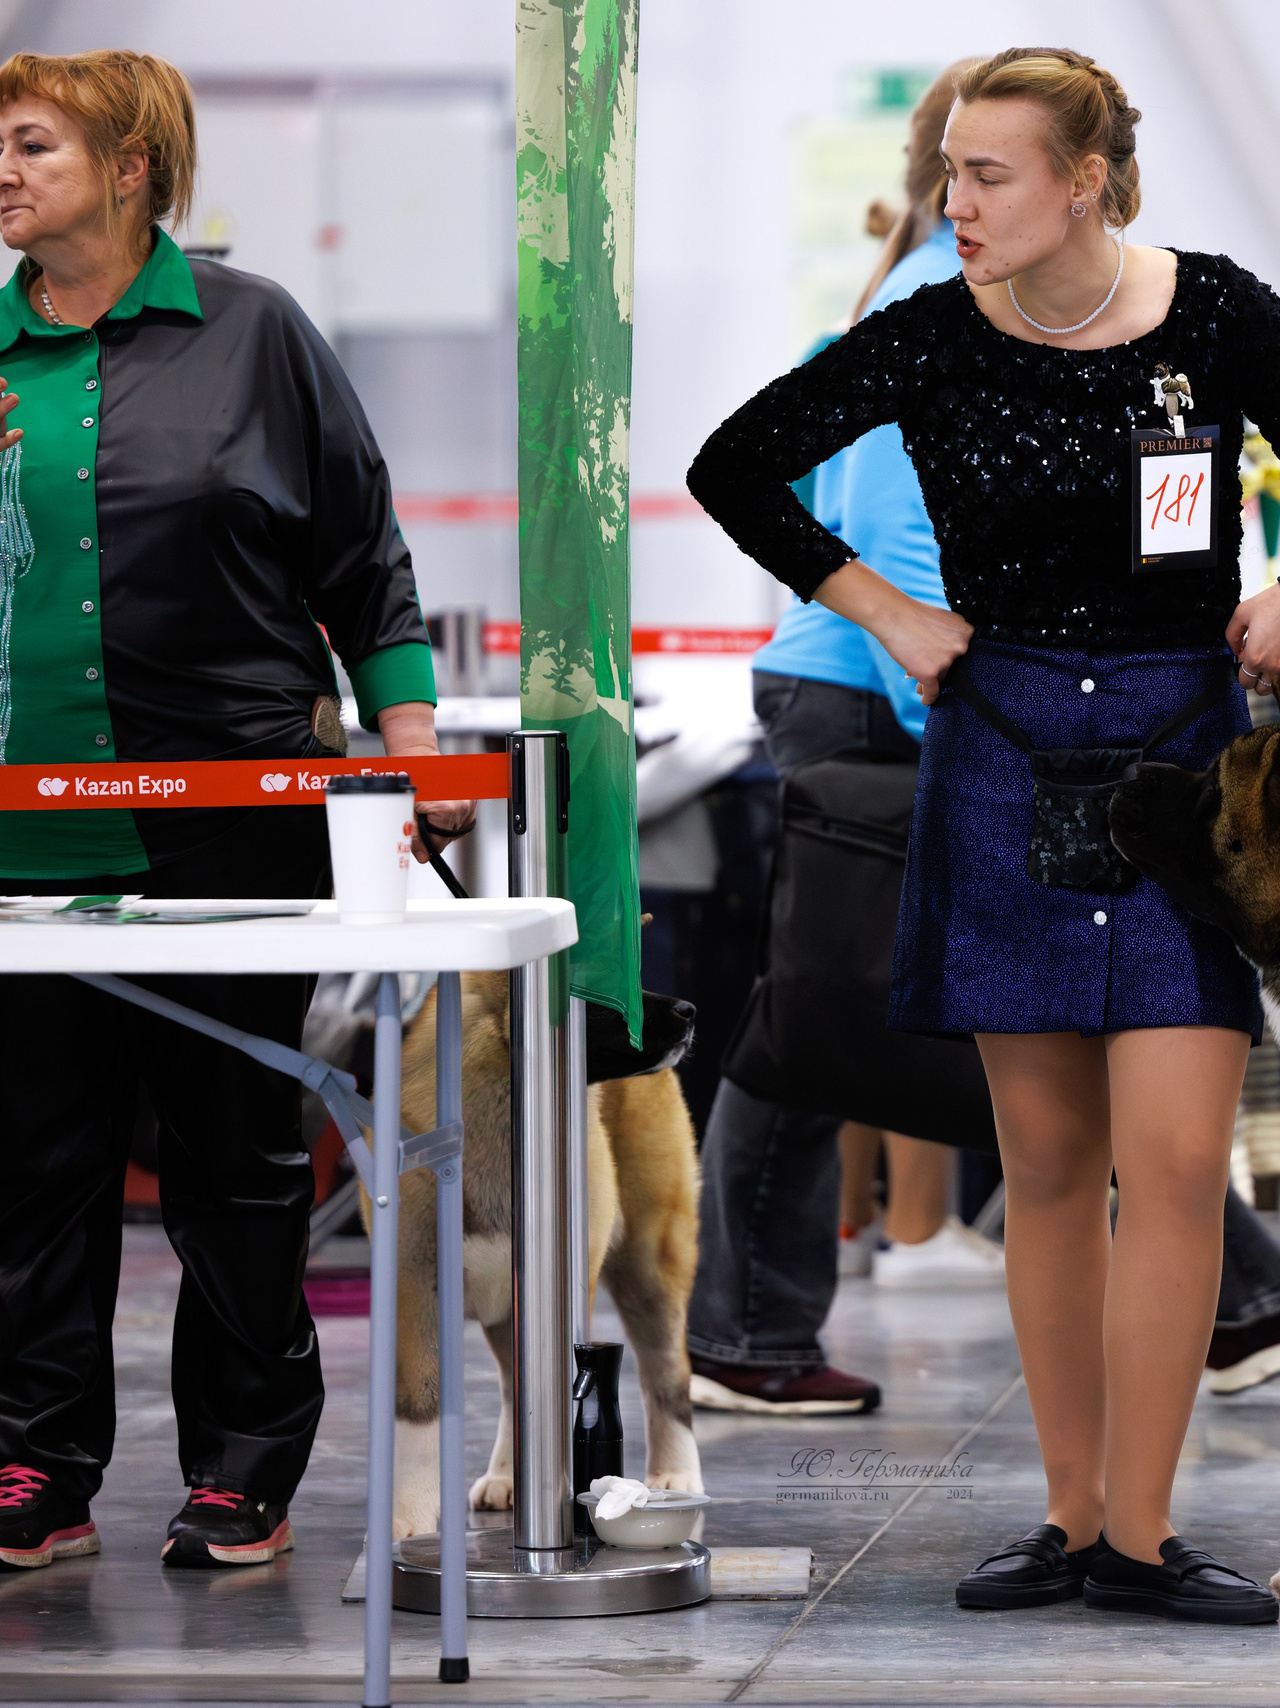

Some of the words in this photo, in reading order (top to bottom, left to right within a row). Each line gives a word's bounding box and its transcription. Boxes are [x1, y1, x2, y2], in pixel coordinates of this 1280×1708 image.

[1140, 438, 1201, 453] PREMIER
[1146, 472, 1204, 530] 181
[75, 777, 134, 796] Kazan
[138, 775, 187, 798] Expo
[297, 772, 355, 791] Kaz
